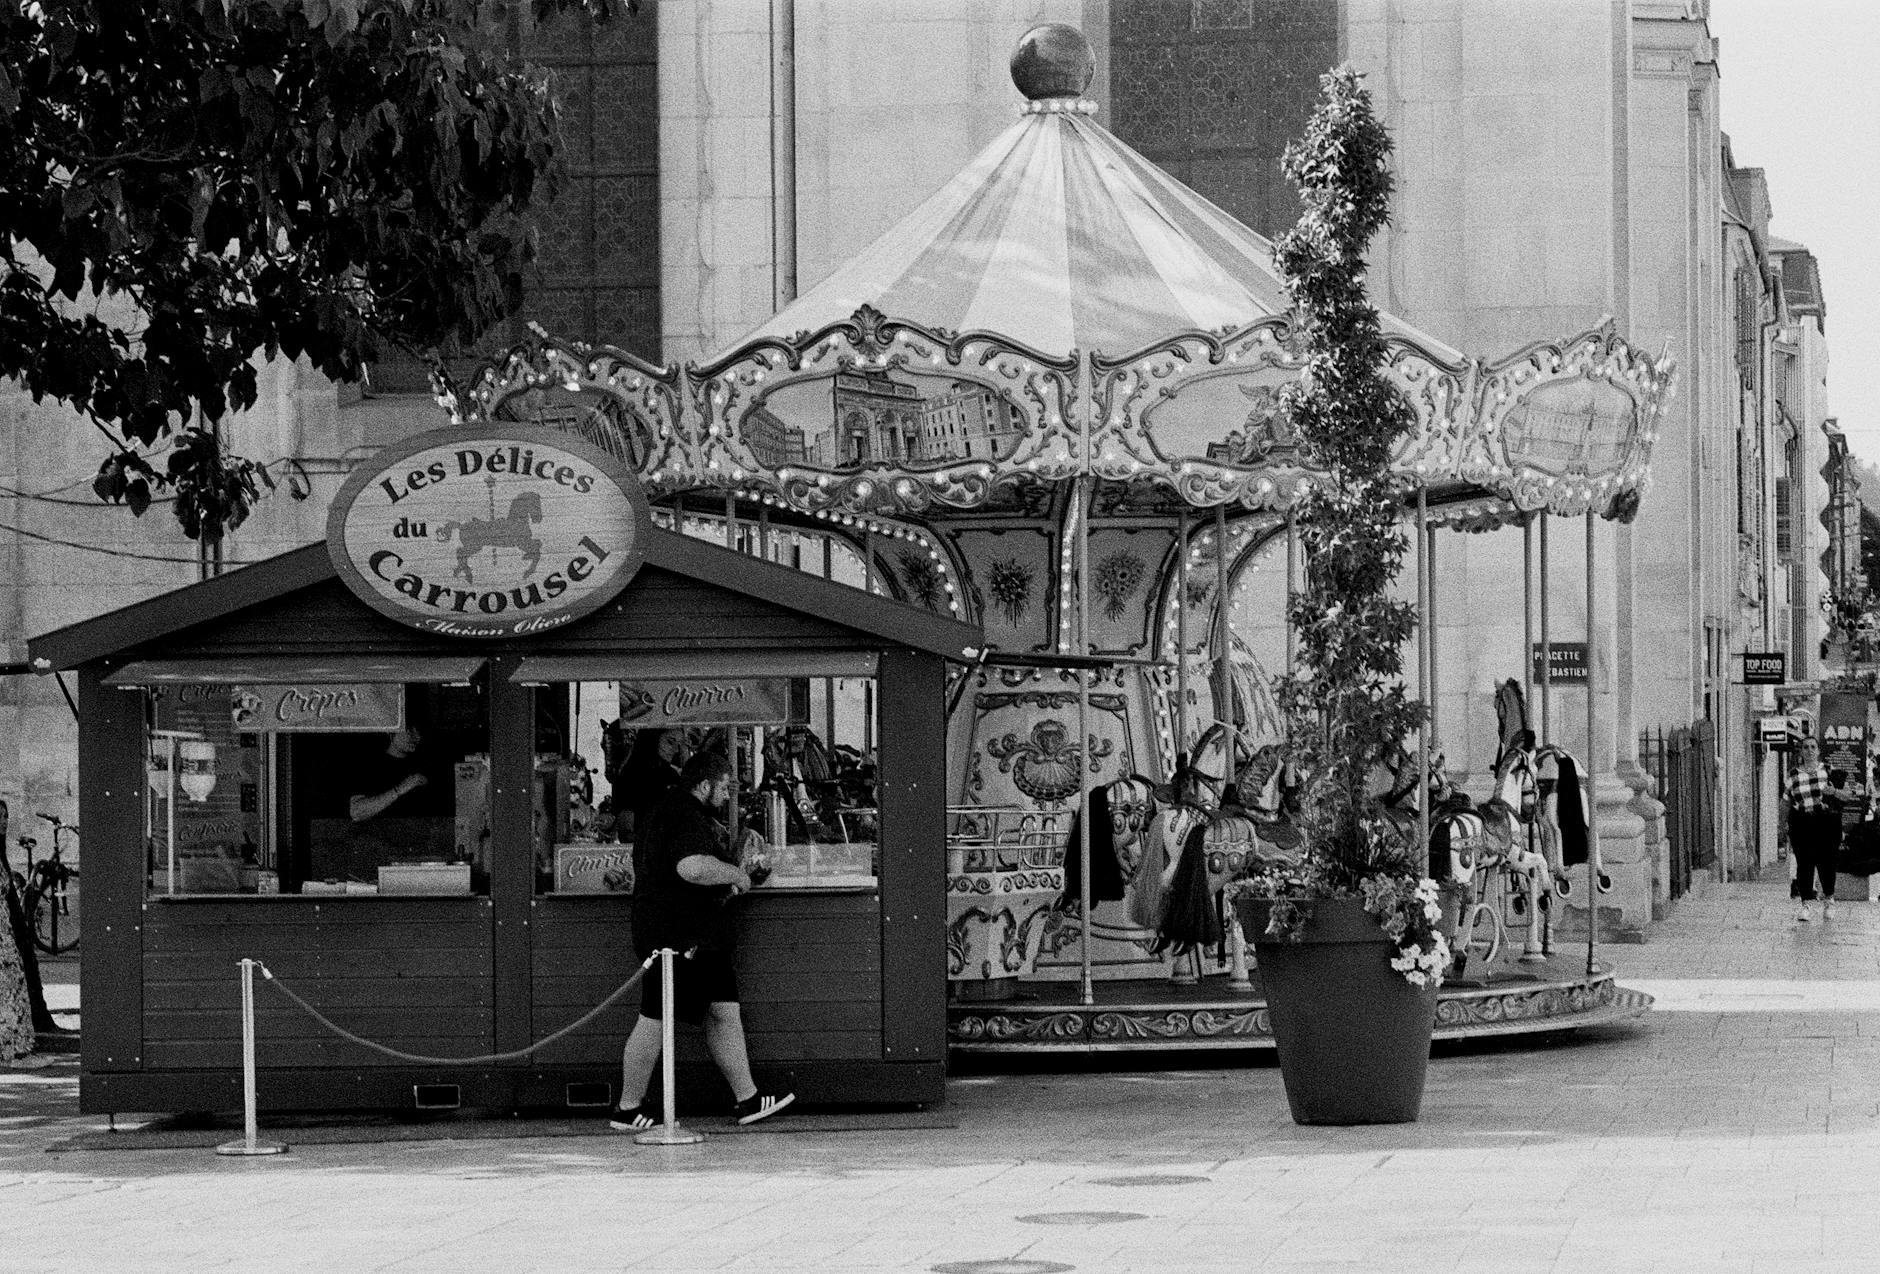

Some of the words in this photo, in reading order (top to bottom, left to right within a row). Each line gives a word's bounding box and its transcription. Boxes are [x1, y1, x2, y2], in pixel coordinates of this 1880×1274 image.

[379, 459, 446, 503] Les
[454, 447, 595, 494] Délices
[393, 517, 427, 538] du
[369, 536, 610, 615] Carrousel
[425, 619, 503, 636] Maison
[1746, 659, 1760, 669] TOP
[1761, 659, 1782, 669] FOOD
[276, 687, 358, 721] Crêpes
[663, 684, 745, 716] Churros
[1824, 725, 1863, 740] ADN
